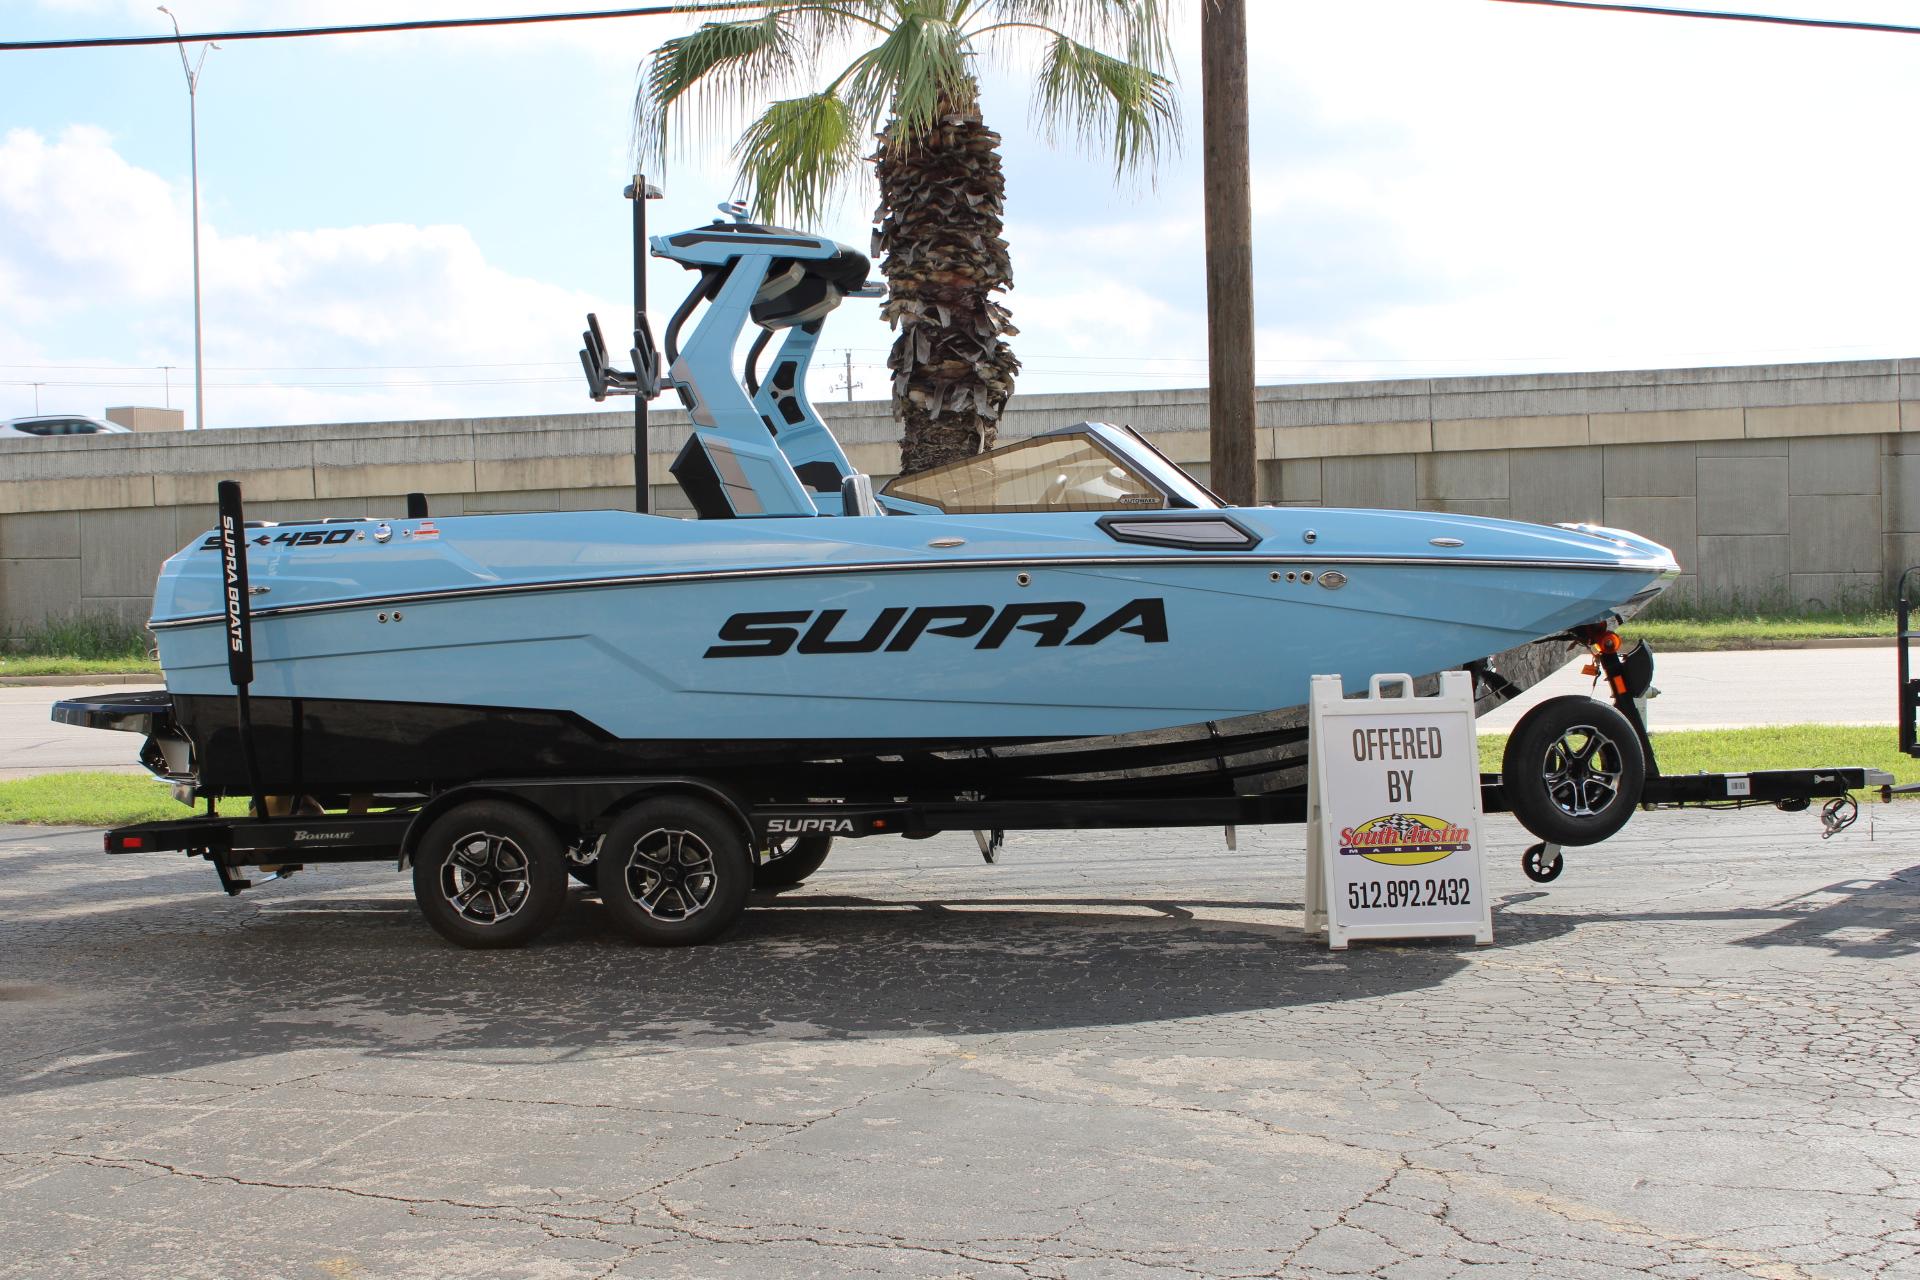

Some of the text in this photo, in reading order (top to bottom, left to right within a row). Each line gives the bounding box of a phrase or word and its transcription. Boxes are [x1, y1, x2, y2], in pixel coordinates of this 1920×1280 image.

[273, 529, 355, 546] 450
[223, 515, 243, 653] SUPRA BOATS
[702, 597, 1169, 659] SUPRA
[1352, 726, 1443, 762] OFFERED
[1387, 769, 1414, 803] BY
[766, 819, 854, 832] SUPRA
[1338, 822, 1469, 847] South Austin
[1348, 844, 1463, 854] MARINE
[1348, 877, 1471, 910] 512.892.2432
